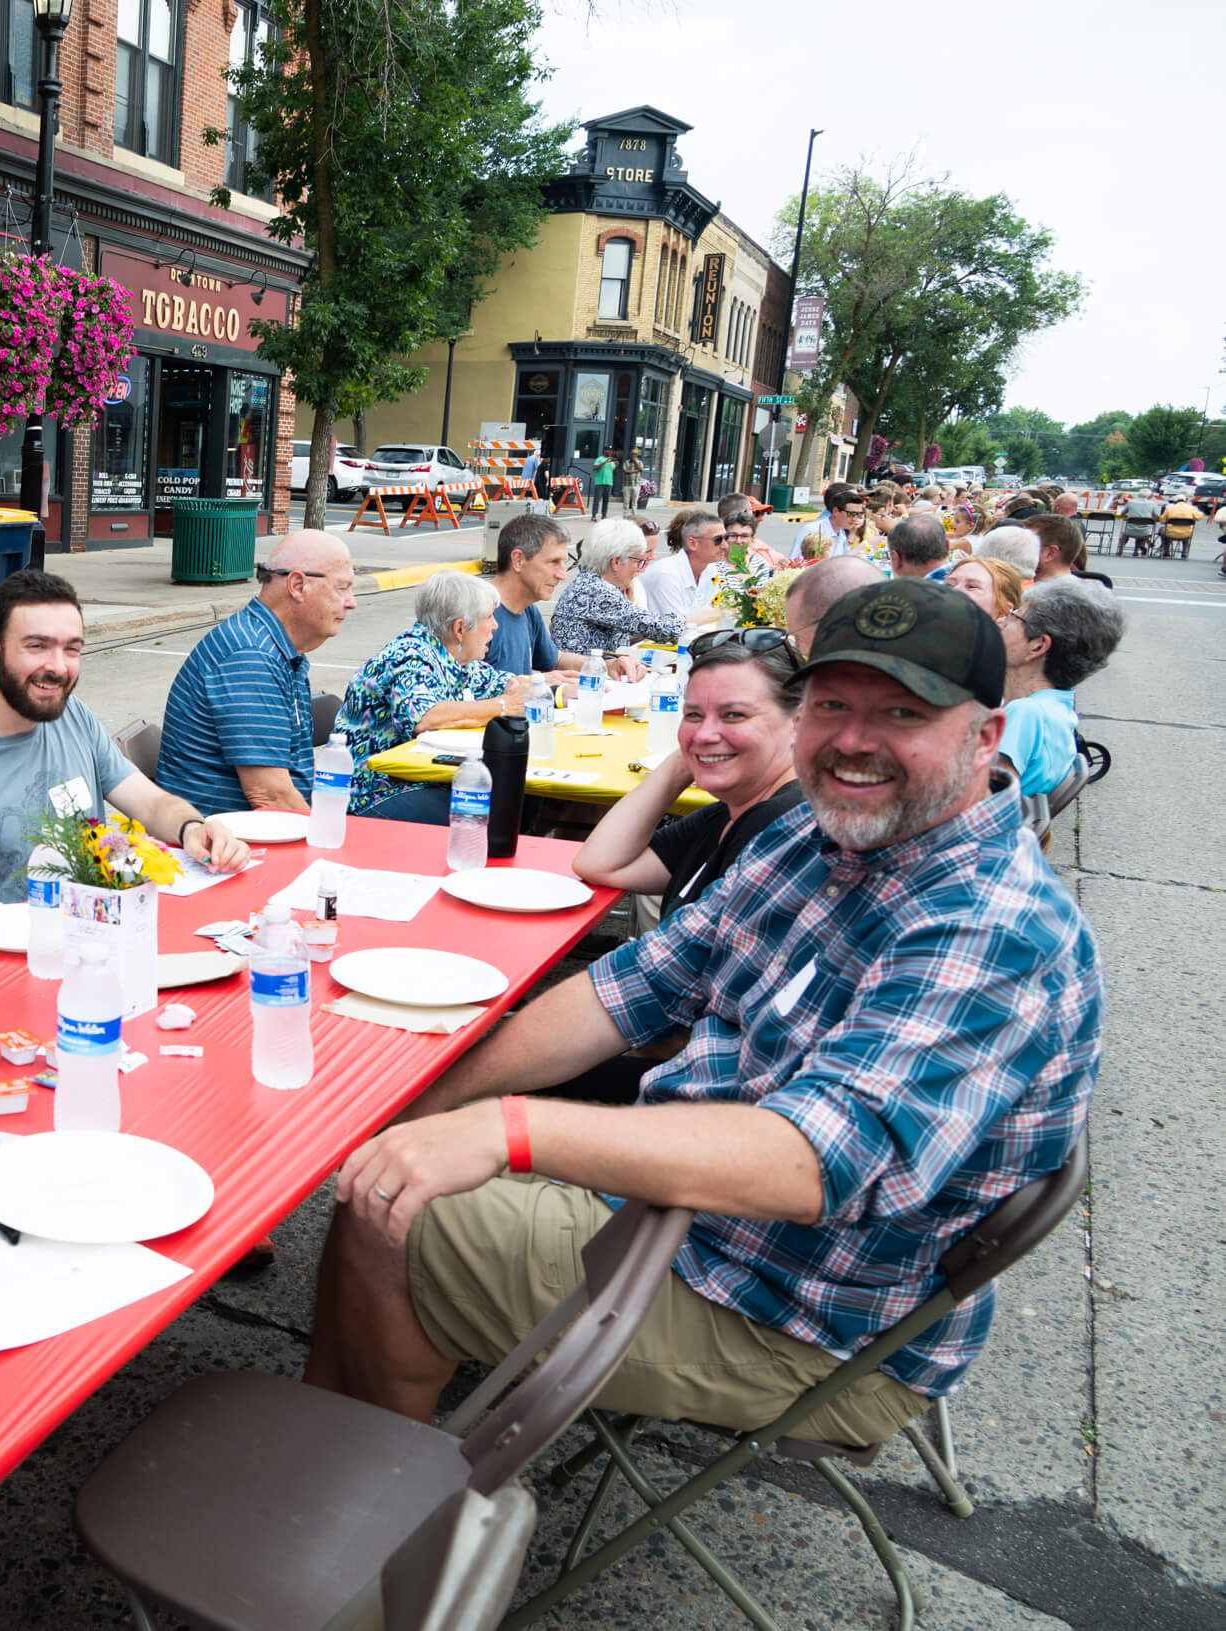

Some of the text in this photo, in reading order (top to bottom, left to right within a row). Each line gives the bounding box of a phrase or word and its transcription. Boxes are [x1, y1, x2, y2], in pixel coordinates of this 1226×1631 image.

[619, 138, 648, 152] 1878
[606, 167, 654, 183] STORE
[170, 267, 221, 293] DONTOWN
[701, 256, 720, 337] REUNION
[142, 288, 240, 342] TOBACCO
[158, 477, 200, 486] COLD POP
[164, 486, 193, 494] CANDY
